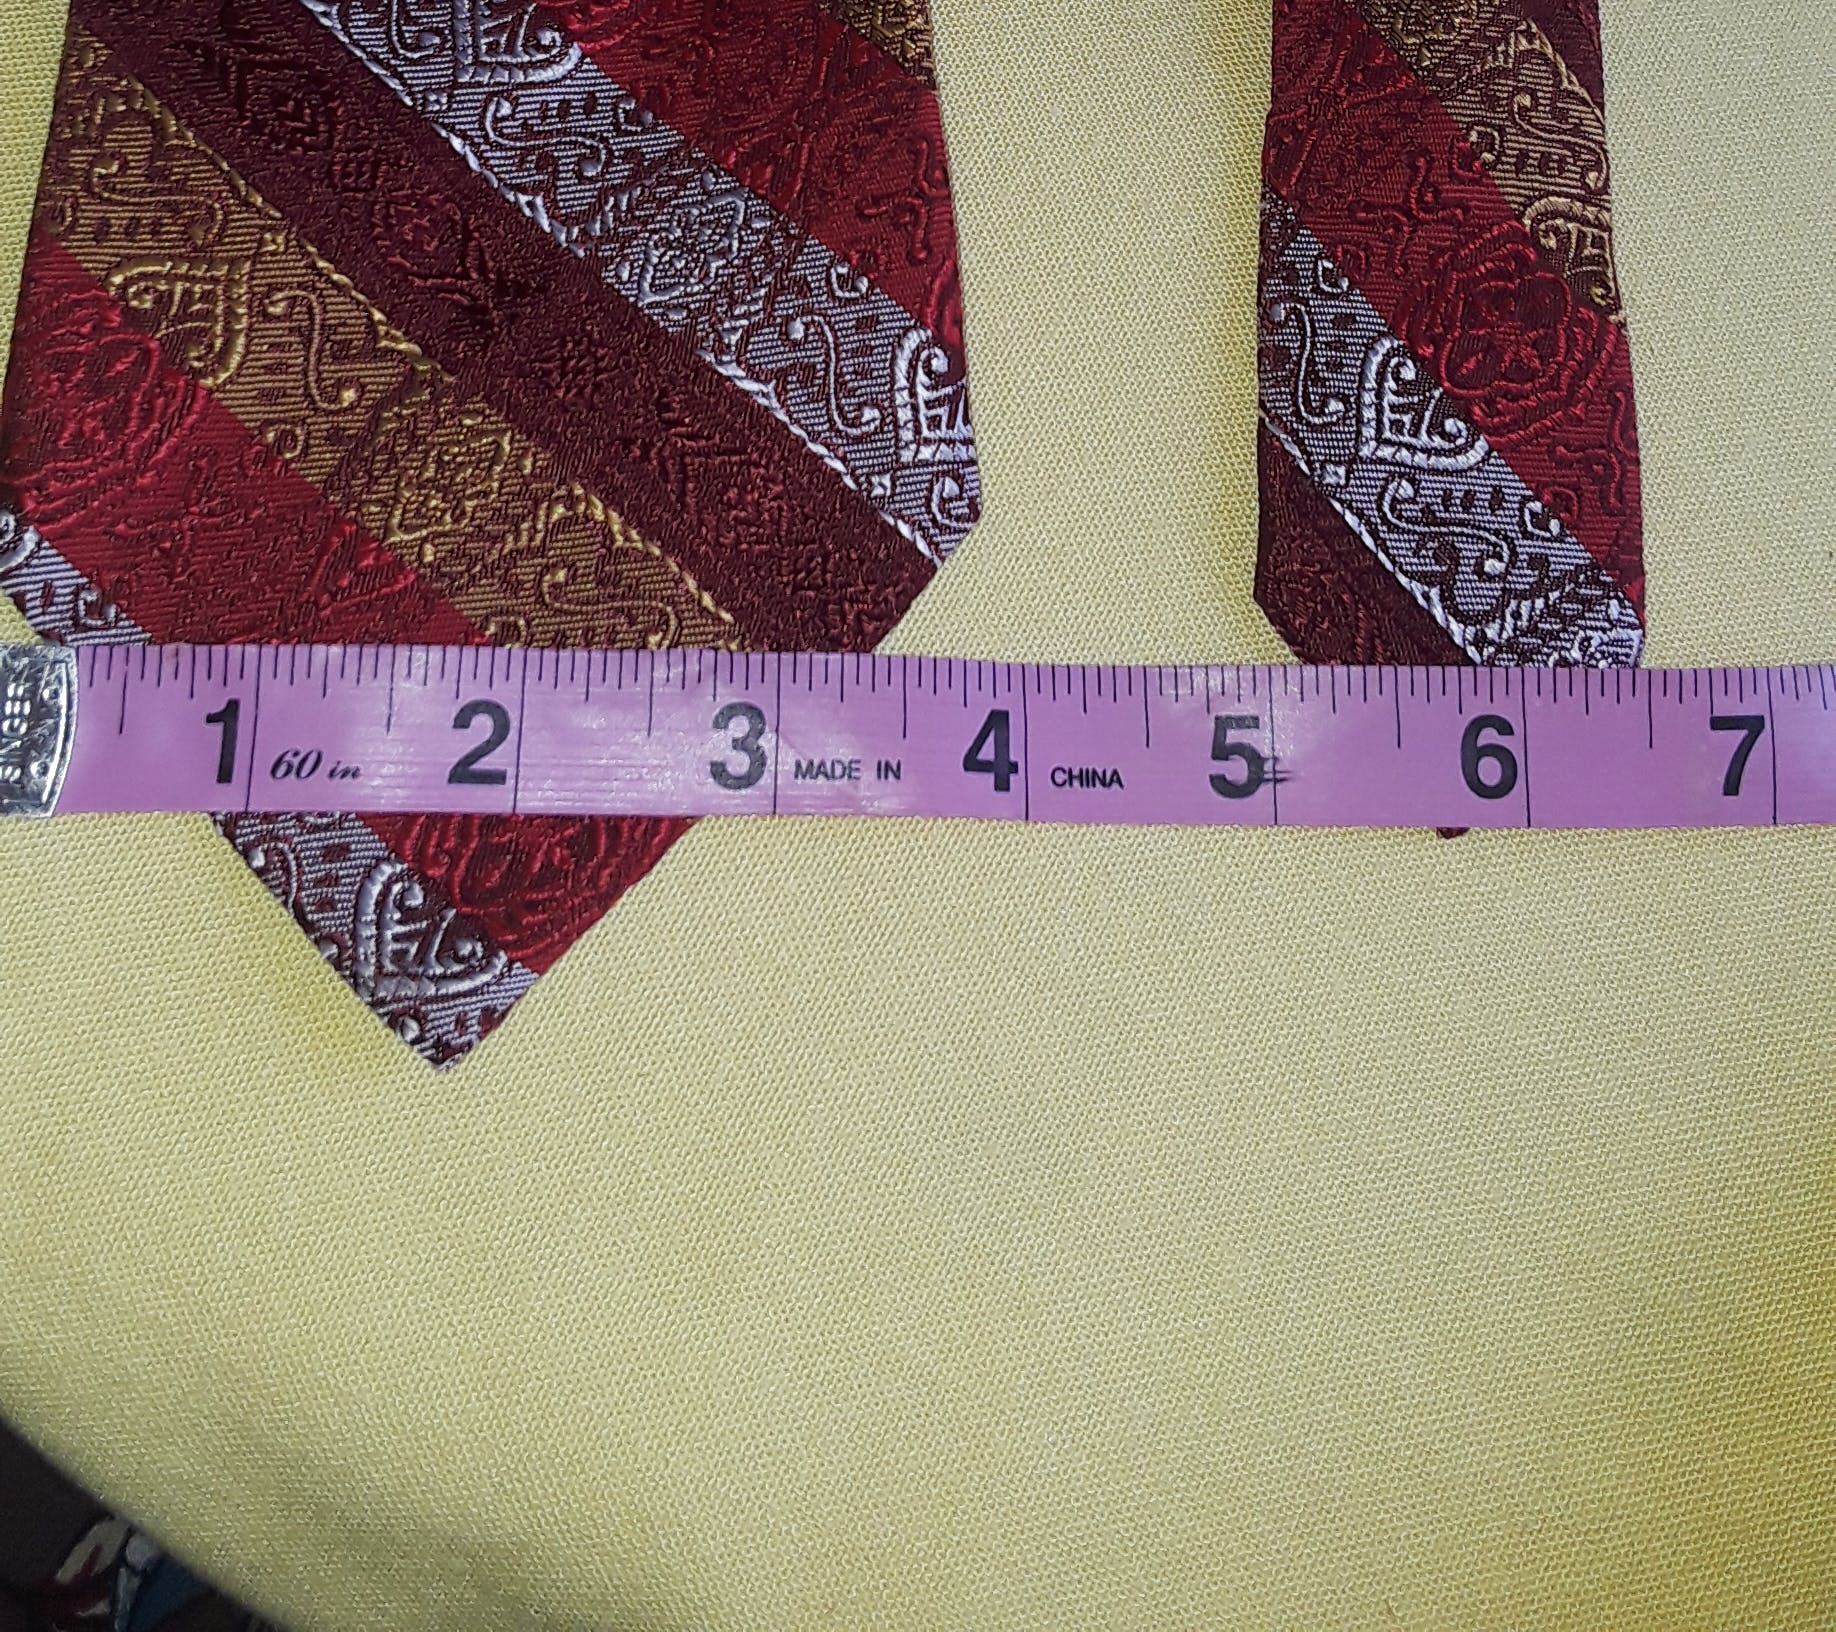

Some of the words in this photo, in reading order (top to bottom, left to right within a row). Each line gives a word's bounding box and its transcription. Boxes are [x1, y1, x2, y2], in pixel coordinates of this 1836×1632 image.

[205, 698, 241, 785] 1
[447, 699, 511, 785] 2
[709, 702, 768, 790] 3
[962, 709, 1018, 793] 4
[1208, 714, 1266, 800] 5
[1460, 714, 1517, 800] 6
[1709, 715, 1765, 798] 7
[270, 749, 323, 781] 60
[328, 759, 361, 779] in
[794, 759, 861, 782] MADE
[877, 759, 902, 781] IN
[1050, 768, 1124, 791] CHINA
